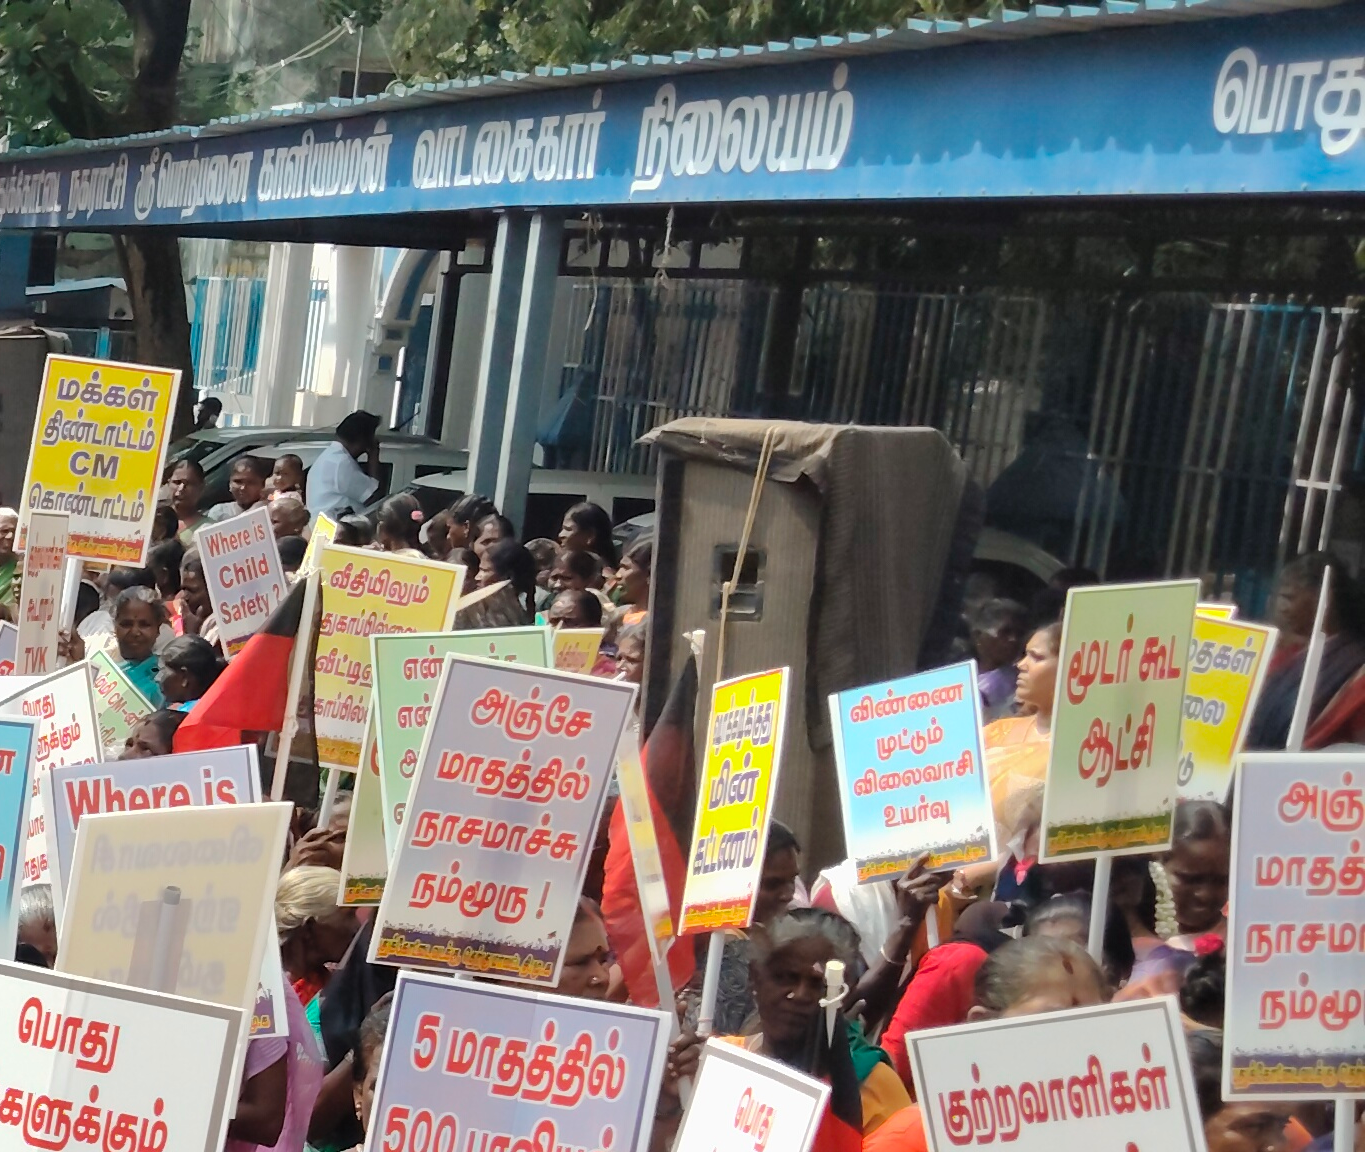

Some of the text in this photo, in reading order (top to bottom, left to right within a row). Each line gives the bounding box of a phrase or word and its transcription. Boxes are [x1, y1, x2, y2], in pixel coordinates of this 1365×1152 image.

[257, 118, 394, 201] காளியம்மன்
[630, 61, 855, 192] நிலையம்
[56, 370, 160, 413] மக்கள்
[41, 409, 156, 452] திண்டாட்டம்
[69, 451, 119, 480] CM
[204, 521, 267, 559] Where is
[218, 559, 270, 590] Child
[330, 562, 429, 607] வீதியிலும்
[218, 591, 270, 626] Safety
[24, 646, 49, 674] TVK
[1067, 613, 1182, 705] மூடர் கூட
[22, 692, 56, 720] பொது
[470, 684, 594, 742] அஞ்சே
[850, 682, 964, 724] விண்ணை
[875, 717, 944, 761] முட்டும்
[1077, 702, 1157, 788] ஆட்சி
[203, 767, 237, 806] is
[436, 745, 591, 806] மாதத்தில்
[708, 752, 761, 810] மின்
[853, 749, 975, 798] விலைவாசி
[883, 794, 951, 829] உயர்வு
[410, 805, 581, 864] நாசமாச்சு
[408, 860, 529, 923] நம்மூரு
[17, 995, 122, 1075] பொது
[411, 1013, 627, 1108] 5 மாதத்தில்
[937, 1043, 1171, 1147] குற்றவாளிகள்
